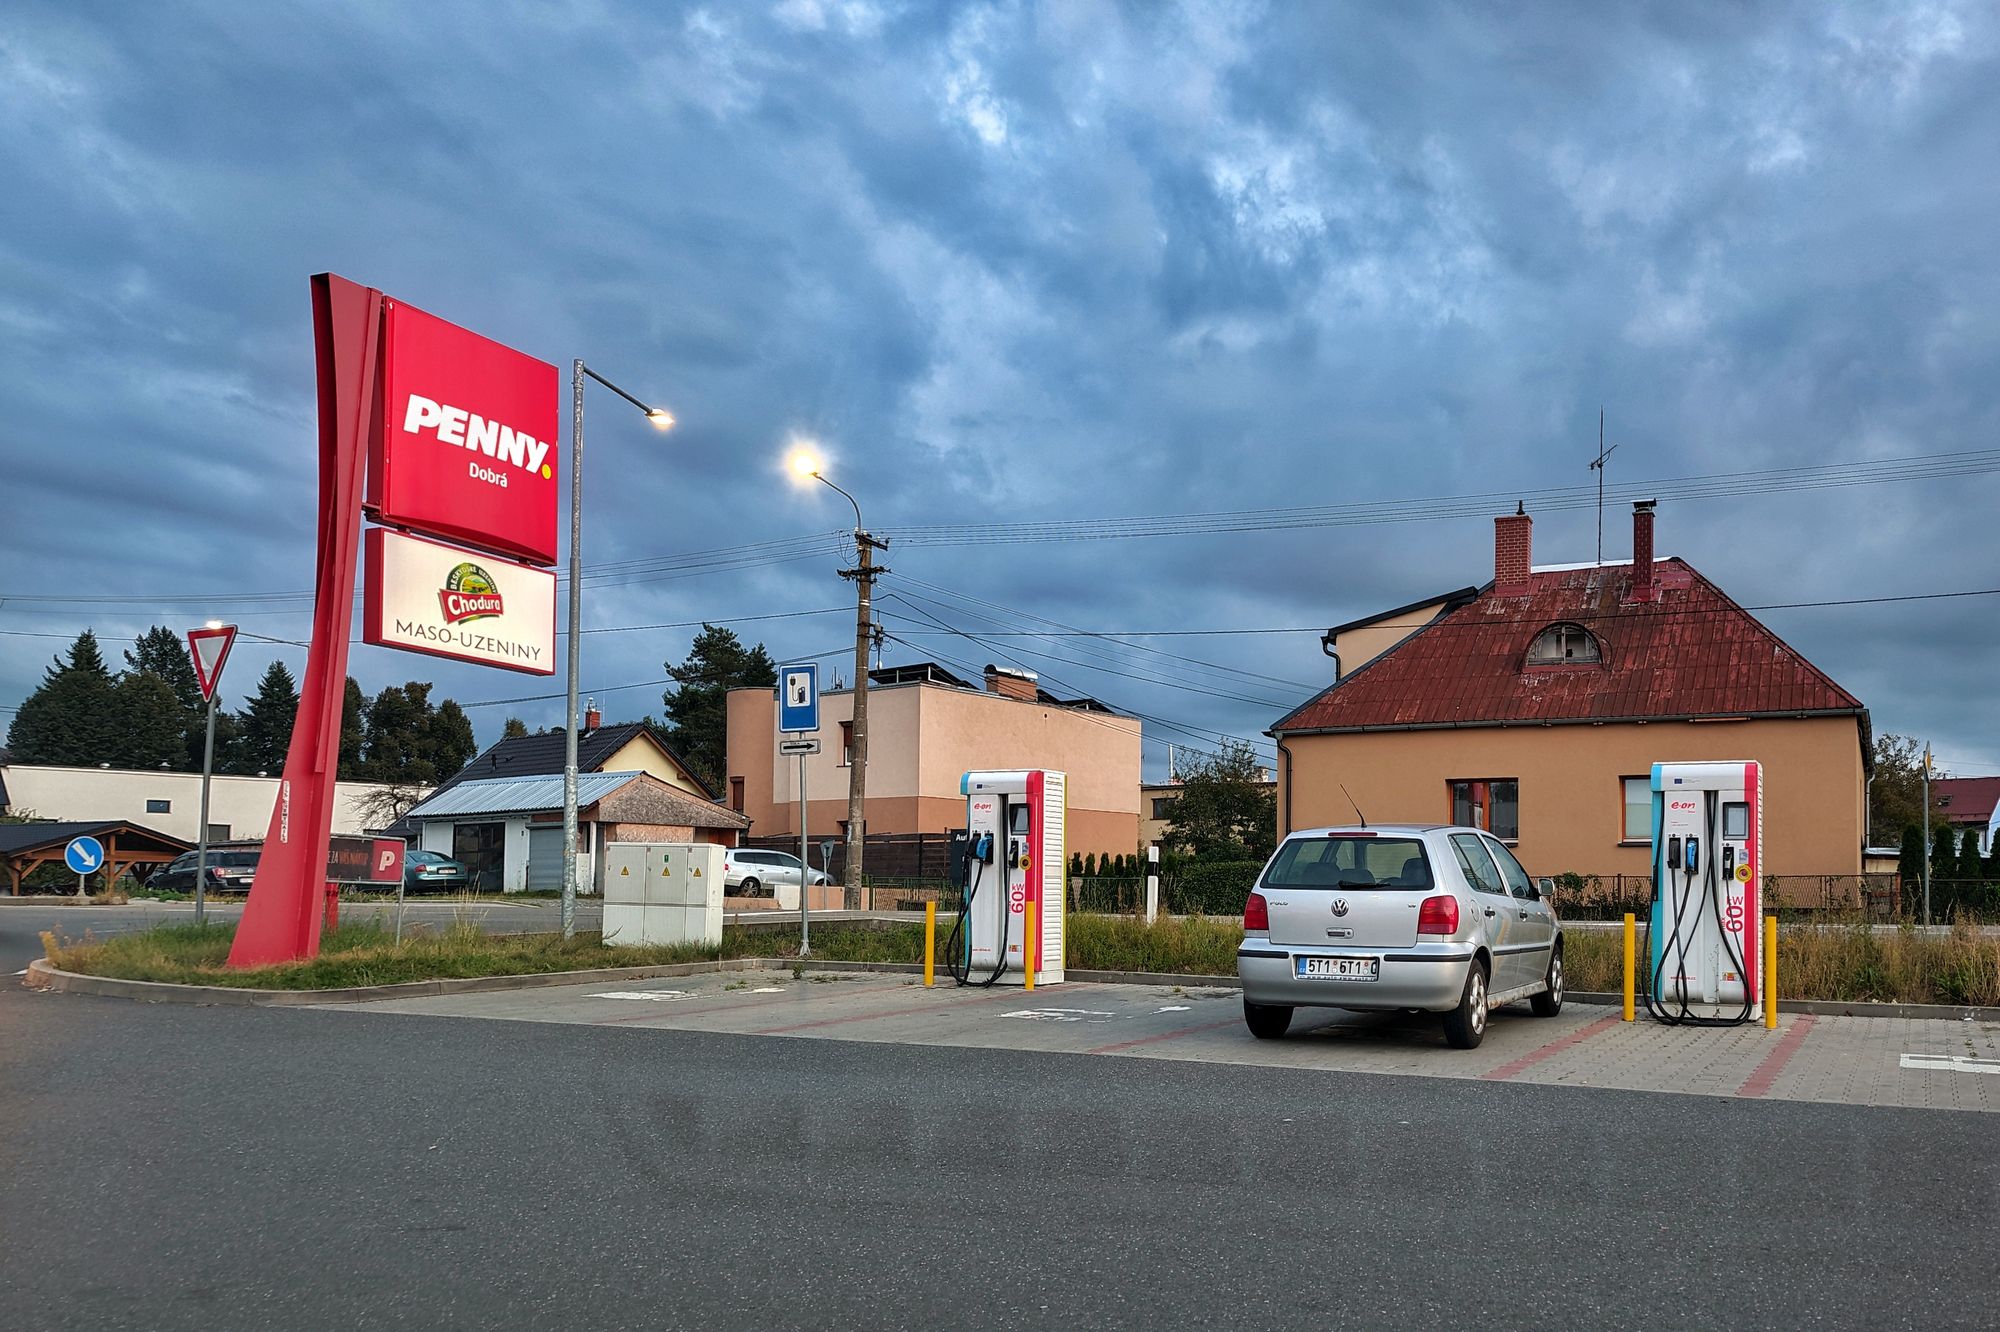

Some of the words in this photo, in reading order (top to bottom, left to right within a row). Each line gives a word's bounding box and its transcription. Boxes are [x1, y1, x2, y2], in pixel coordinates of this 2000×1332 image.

[469, 462, 508, 488] Dobrá
[447, 594, 501, 616] Chodura
[395, 618, 541, 661] MASO-UZENINY
[378, 850, 396, 872] P
[1011, 891, 1024, 914] 60
[1725, 905, 1744, 933] 60
[1308, 959, 1330, 974] 5T1
